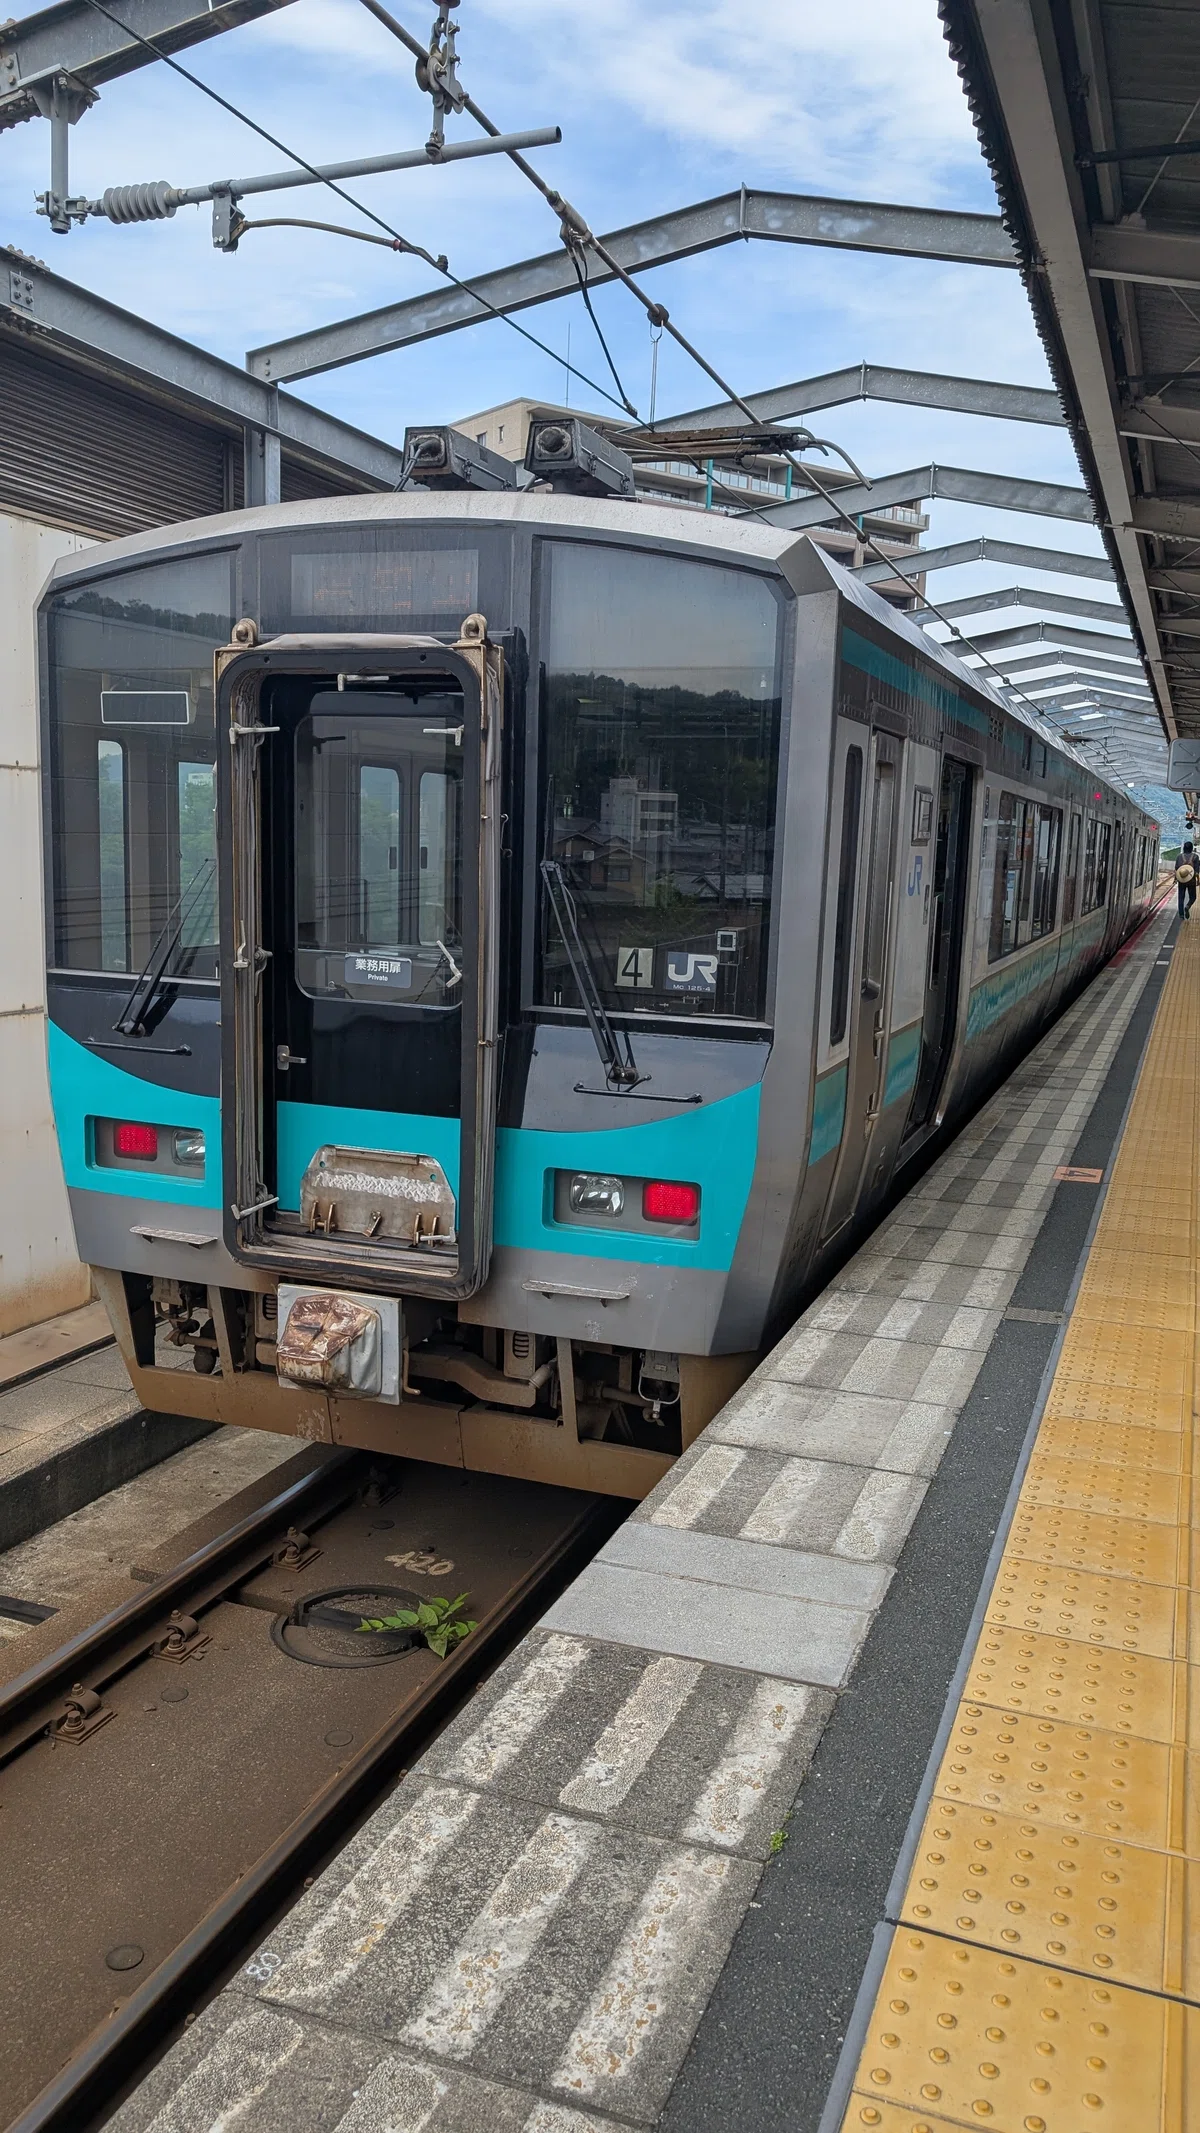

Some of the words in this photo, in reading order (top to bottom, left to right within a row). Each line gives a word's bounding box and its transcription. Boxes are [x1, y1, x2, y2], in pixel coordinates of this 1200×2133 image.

[907, 855, 923, 897] JR
[355, 958, 402, 974] 業務用扉
[367, 973, 389, 982] Private
[621, 948, 643, 987] 4
[667, 953, 718, 984] JR
